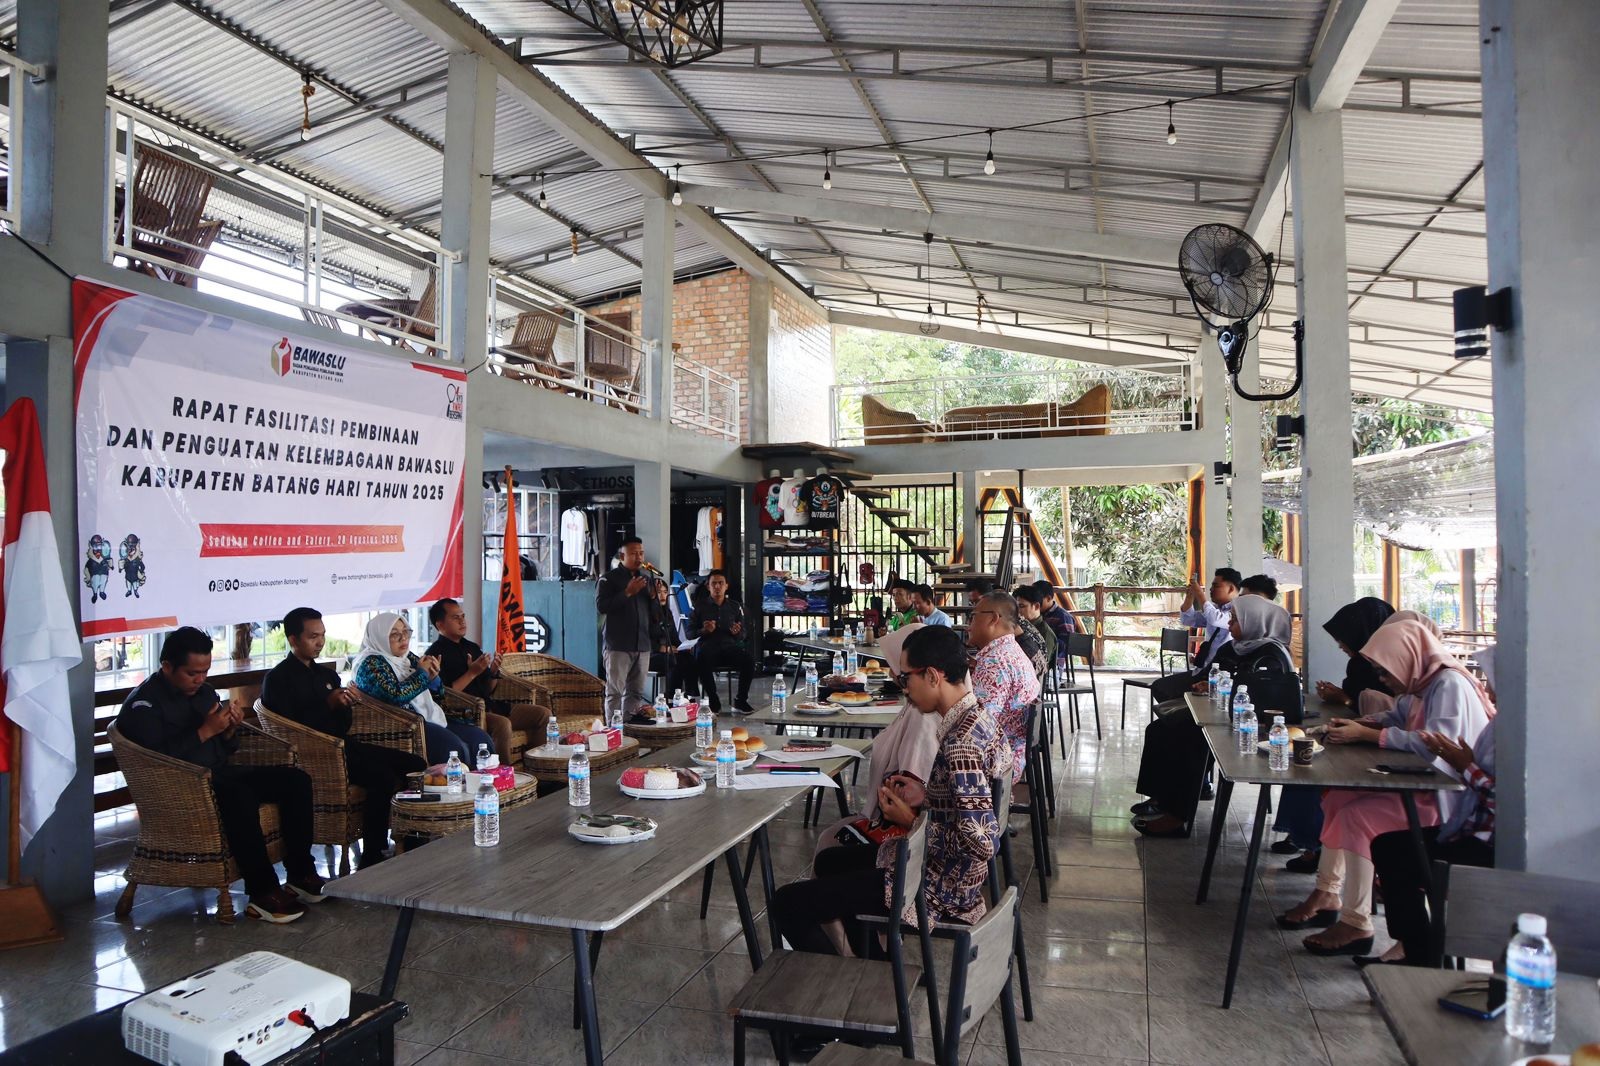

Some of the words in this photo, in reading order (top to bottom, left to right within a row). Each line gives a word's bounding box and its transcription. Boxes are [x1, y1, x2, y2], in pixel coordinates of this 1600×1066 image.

[293, 346, 347, 370] BAWASLU
[172, 396, 238, 424] RAPAT
[244, 406, 335, 436] FASILITASI
[340, 420, 419, 446] PEMBINAAN
[106, 425, 154, 450] DAN
[161, 431, 279, 462] PENGUATAN
[285, 444, 394, 471] KELEMBAGAAN
[397, 456, 455, 476] BAWASLU
[121, 464, 246, 492] KABUPATEN
[251, 473, 320, 495] BATANG
[325, 478, 361, 497] HARI
[366, 481, 408, 499] TAHUN
[412, 485, 444, 501] 2025
[286, 535, 302, 546] and
[381, 534, 399, 545] 2025
[259, 579, 283, 587] Kabupaten
